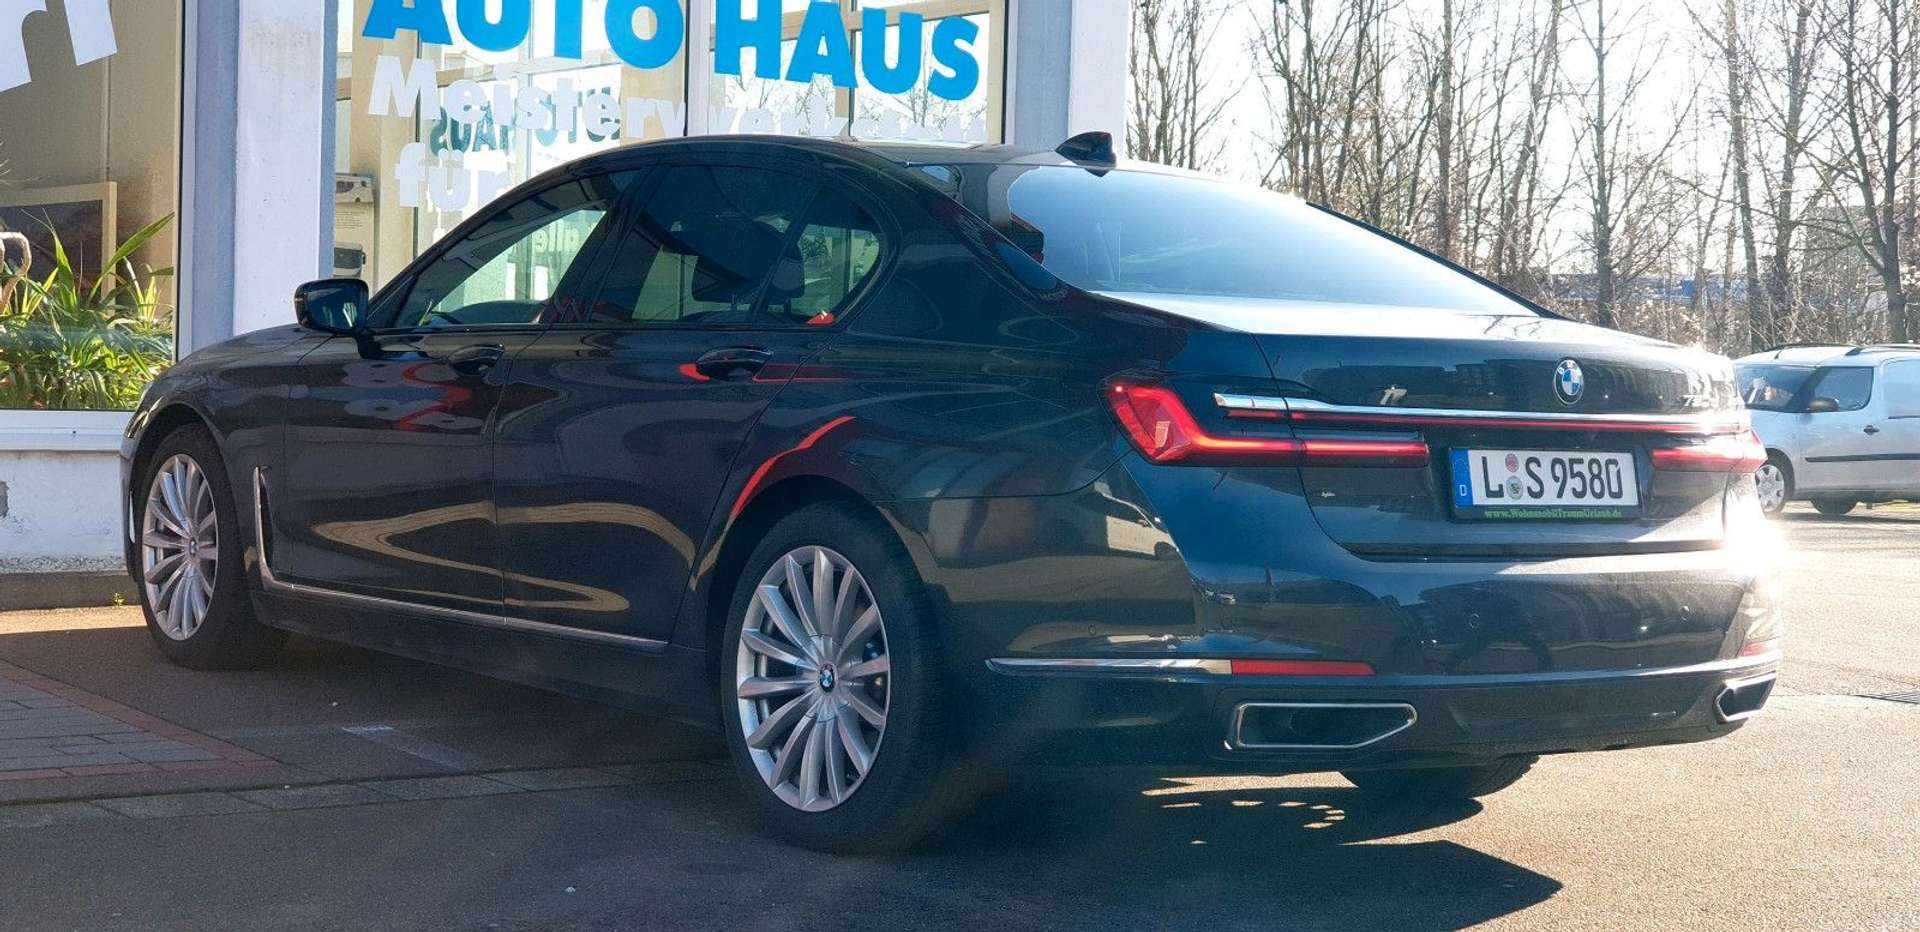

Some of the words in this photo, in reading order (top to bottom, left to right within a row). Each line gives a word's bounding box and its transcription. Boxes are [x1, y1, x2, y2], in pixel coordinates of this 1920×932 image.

[714, 0, 979, 101] HAUS
[394, 142, 511, 213] für
[1482, 456, 1504, 498] L
[1525, 457, 1544, 499] S
[1551, 457, 1623, 499] 9580
